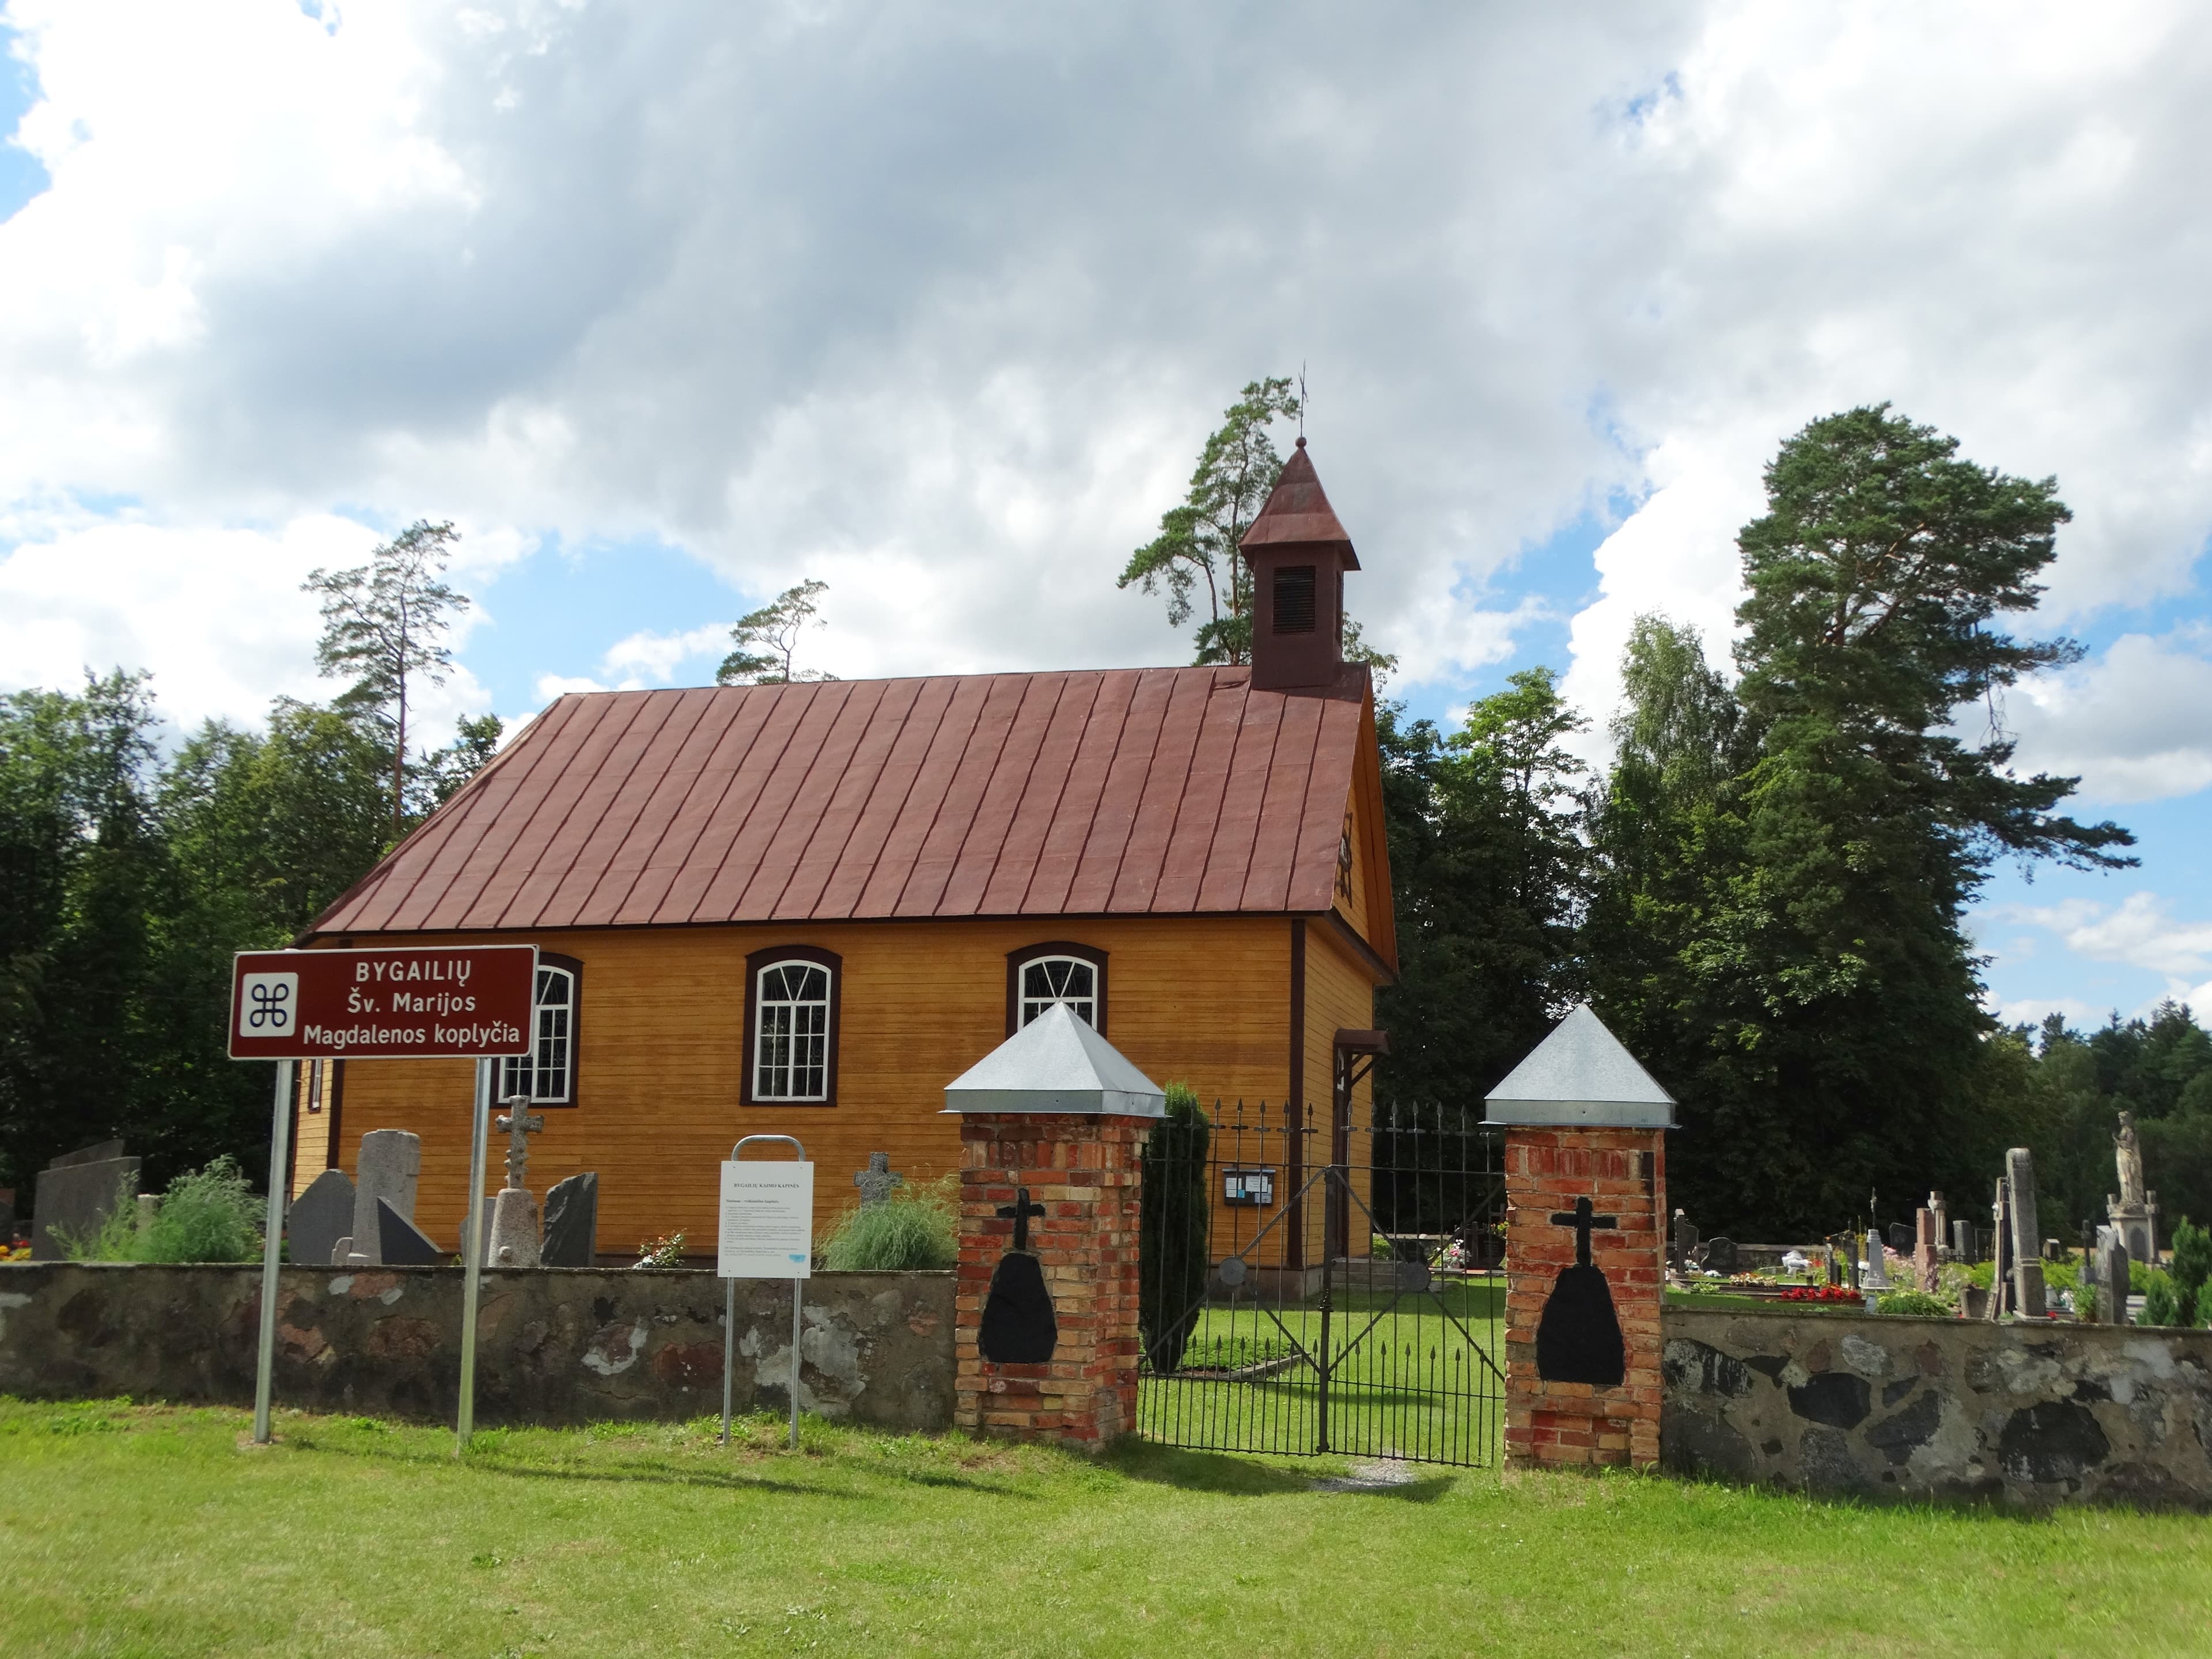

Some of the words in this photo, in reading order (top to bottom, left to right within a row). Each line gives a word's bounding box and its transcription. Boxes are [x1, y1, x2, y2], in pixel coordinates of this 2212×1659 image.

[356, 960, 471, 987] BYGAILIŲ
[347, 987, 380, 1013] Šv.
[393, 992, 475, 1017] Marijos
[304, 1024, 426, 1050] Magdalenos
[434, 1020, 520, 1048] koplyčia
